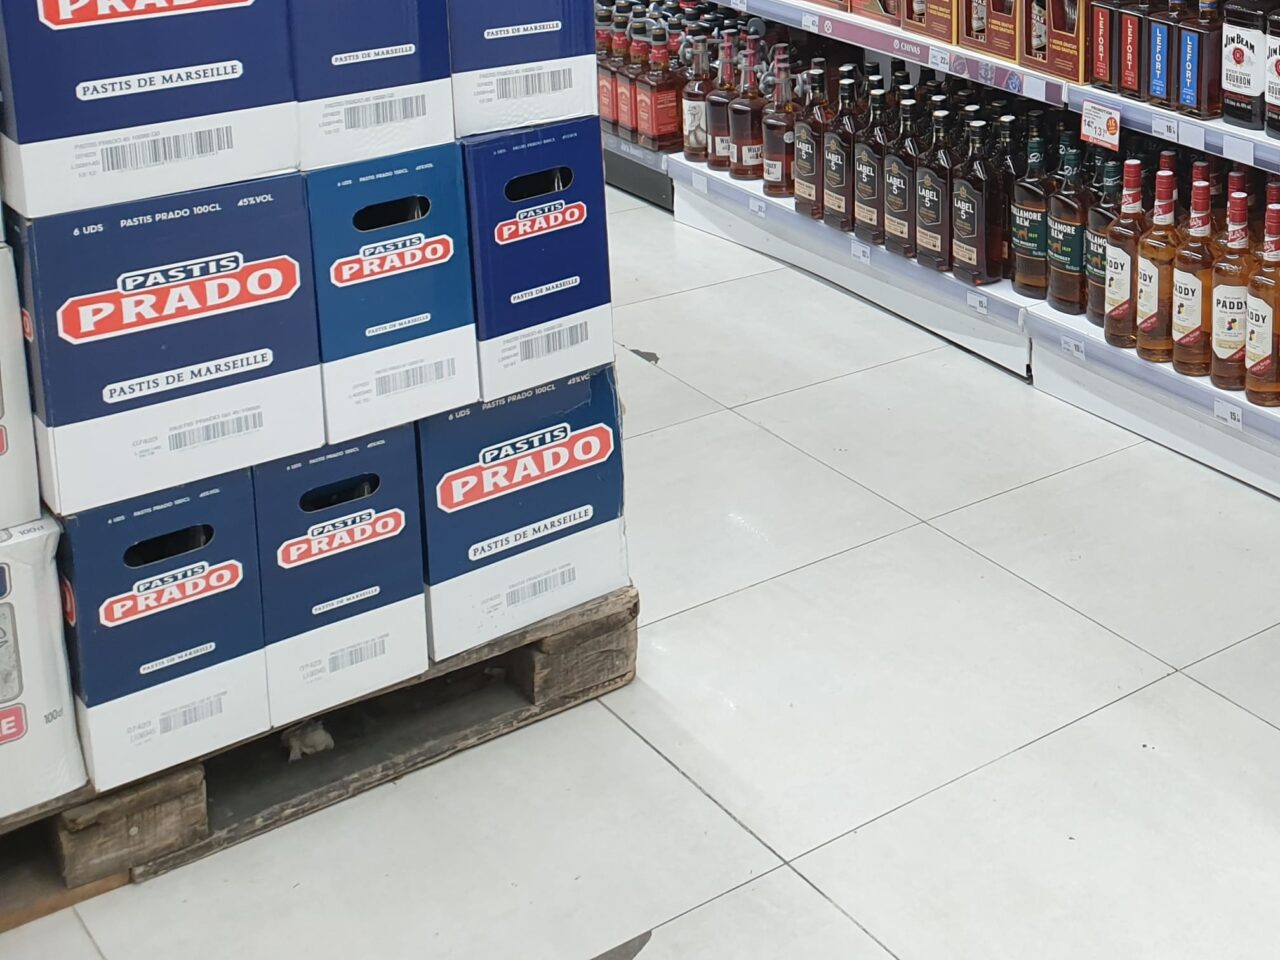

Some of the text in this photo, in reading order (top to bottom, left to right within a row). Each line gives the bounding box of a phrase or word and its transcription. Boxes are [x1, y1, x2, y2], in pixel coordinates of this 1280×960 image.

[82, 64, 239, 96] PASTIS DE MARSEILLE
[856, 160, 875, 176] LABEL
[886, 173, 905, 188] LABEL
[918, 185, 938, 201] LABEL
[954, 199, 974, 213] LABEL
[120, 203, 222, 228] PASTIS PRADO 100CL
[503, 207, 580, 239] PRADO
[519, 202, 563, 220] PASTIS
[72, 223, 104, 236] 6 UDS
[363, 236, 422, 256] PASTIS
[124, 257, 236, 290] PASTIS
[341, 243, 444, 281] PRADO
[78, 268, 283, 333] PRADO
[108, 353, 269, 398] PASTIS DE MARSEILLE
[482, 397, 506, 410] PASTIS
[507, 390, 533, 404] PRADO
[484, 426, 567, 463] PASTIS
[451, 435, 601, 504] PRADO
[313, 512, 372, 535] PASTIS
[472, 508, 590, 557] PASTIS DE MARSEILLE
[289, 517, 395, 561] PRADO
[137, 564, 206, 592] PASTIS
[112, 569, 232, 620] PRADO
